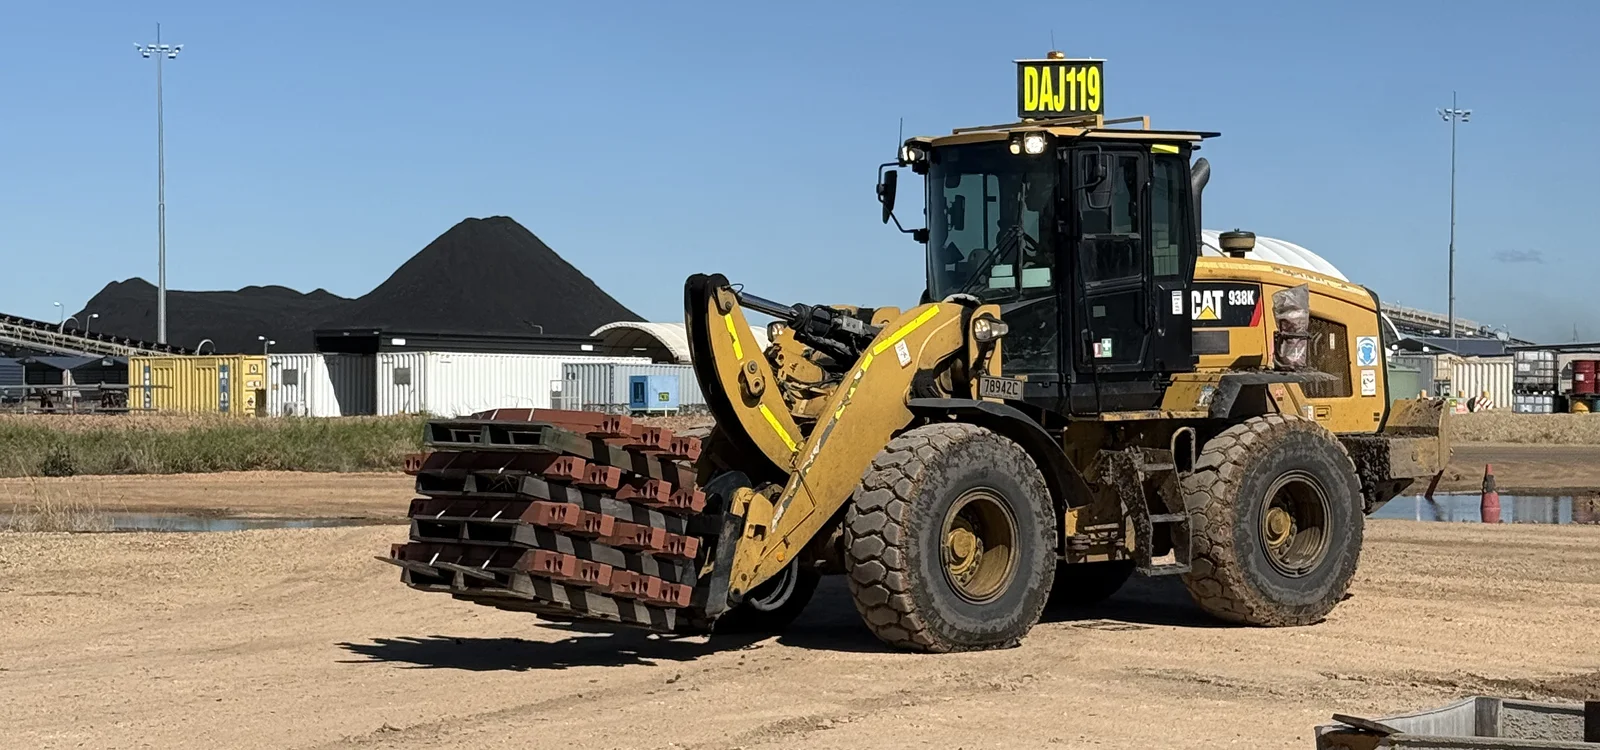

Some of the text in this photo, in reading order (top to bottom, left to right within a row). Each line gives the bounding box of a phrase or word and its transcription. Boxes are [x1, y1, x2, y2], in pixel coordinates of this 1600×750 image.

[1024, 66, 1100, 112] DAJ119
[1191, 290, 1224, 320] CAT
[1228, 290, 1254, 306] 938K
[984, 379, 1018, 395] 78942C
